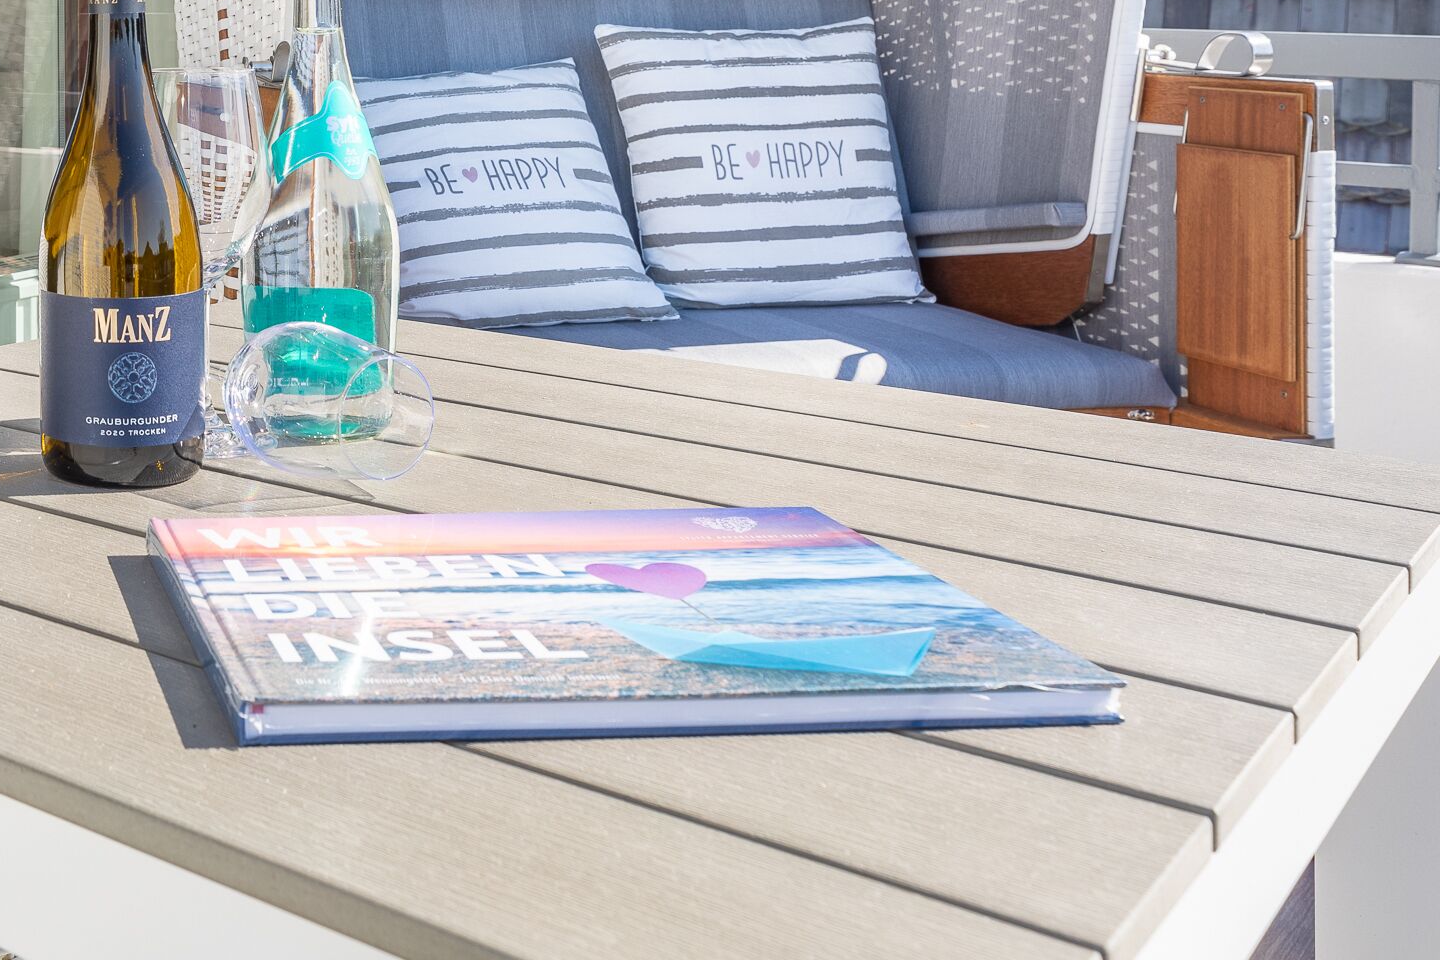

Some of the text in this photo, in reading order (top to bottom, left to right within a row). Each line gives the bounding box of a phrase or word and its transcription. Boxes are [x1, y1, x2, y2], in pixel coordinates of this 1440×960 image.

[711, 139, 844, 181] BE HAPPY
[424, 156, 567, 196] BE HAPPY
[93, 305, 172, 344] MANZ
[85, 413, 179, 427] GRAUBURGUNDER
[100, 427, 167, 437] 2020 TROCKEN
[196, 525, 384, 550] WIR
[223, 553, 567, 582] LIEBEN
[244, 591, 422, 621] DIE
[267, 628, 590, 663] INSEL
